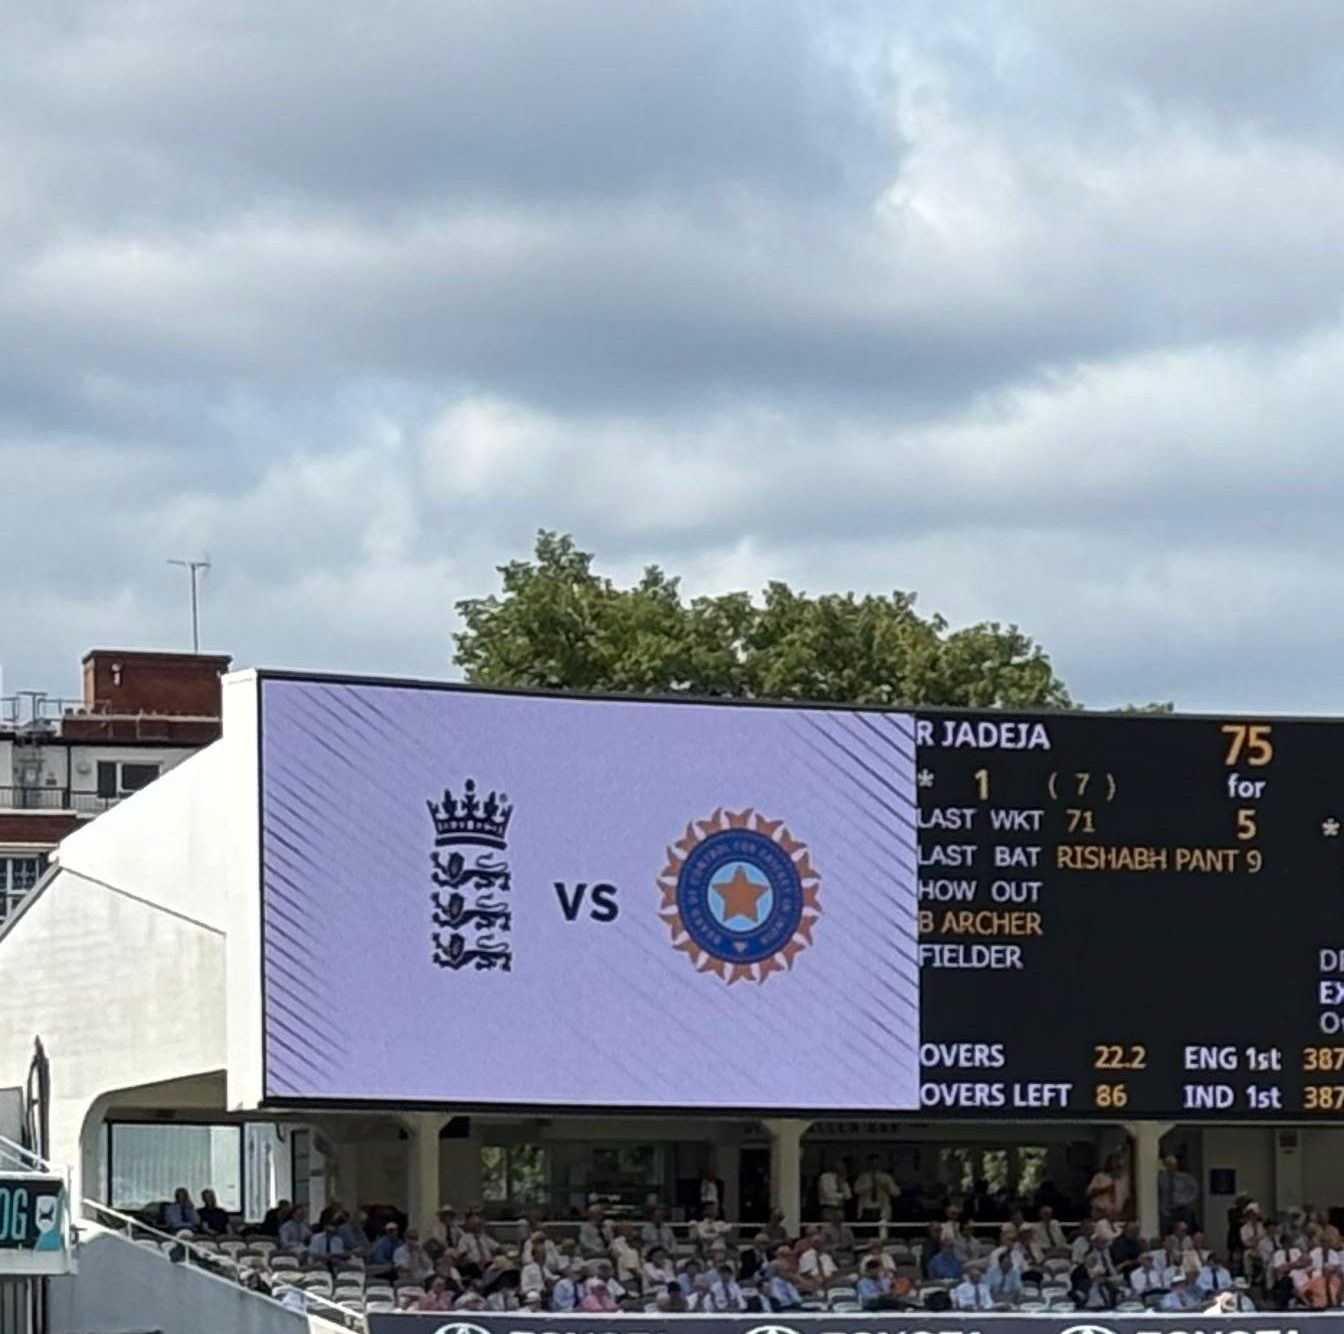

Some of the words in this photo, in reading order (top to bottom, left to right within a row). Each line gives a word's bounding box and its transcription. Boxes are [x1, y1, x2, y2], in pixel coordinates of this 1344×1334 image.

[917, 721, 934, 746] R
[942, 721, 1050, 749] JADEJA
[1222, 725, 1272, 765] 75
[975, 770, 987, 799] 1
[1228, 774, 1265, 798] for
[917, 808, 976, 829] LAST
[991, 810, 1044, 830] WKT
[1067, 809, 1094, 832] 71
[1238, 810, 1256, 839] 5
[917, 844, 977, 866] LAST
[995, 846, 1041, 866] BAT
[1058, 846, 1167, 870] RISHABH
[1176, 849, 1239, 871] PANT
[1247, 850, 1261, 872] 9
[553, 882, 619, 922] VS
[918, 880, 976, 900] HOW
[992, 881, 1042, 902] OUT
[918, 911, 935, 934] B
[941, 911, 1042, 935] ARCHER
[919, 945, 1023, 970] FIELDER
[920, 1044, 1005, 1068] OVERS
[1095, 1046, 1145, 1068] 22.2
[1185, 1047, 1237, 1069] ENG
[1246, 1048, 1281, 1070] 1st
[920, 1084, 1005, 1107] OVERS
[1014, 1084, 1072, 1106] LEFT
[1185, 1085, 1233, 1108] IND
[1247, 1086, 1281, 1108] 1st
